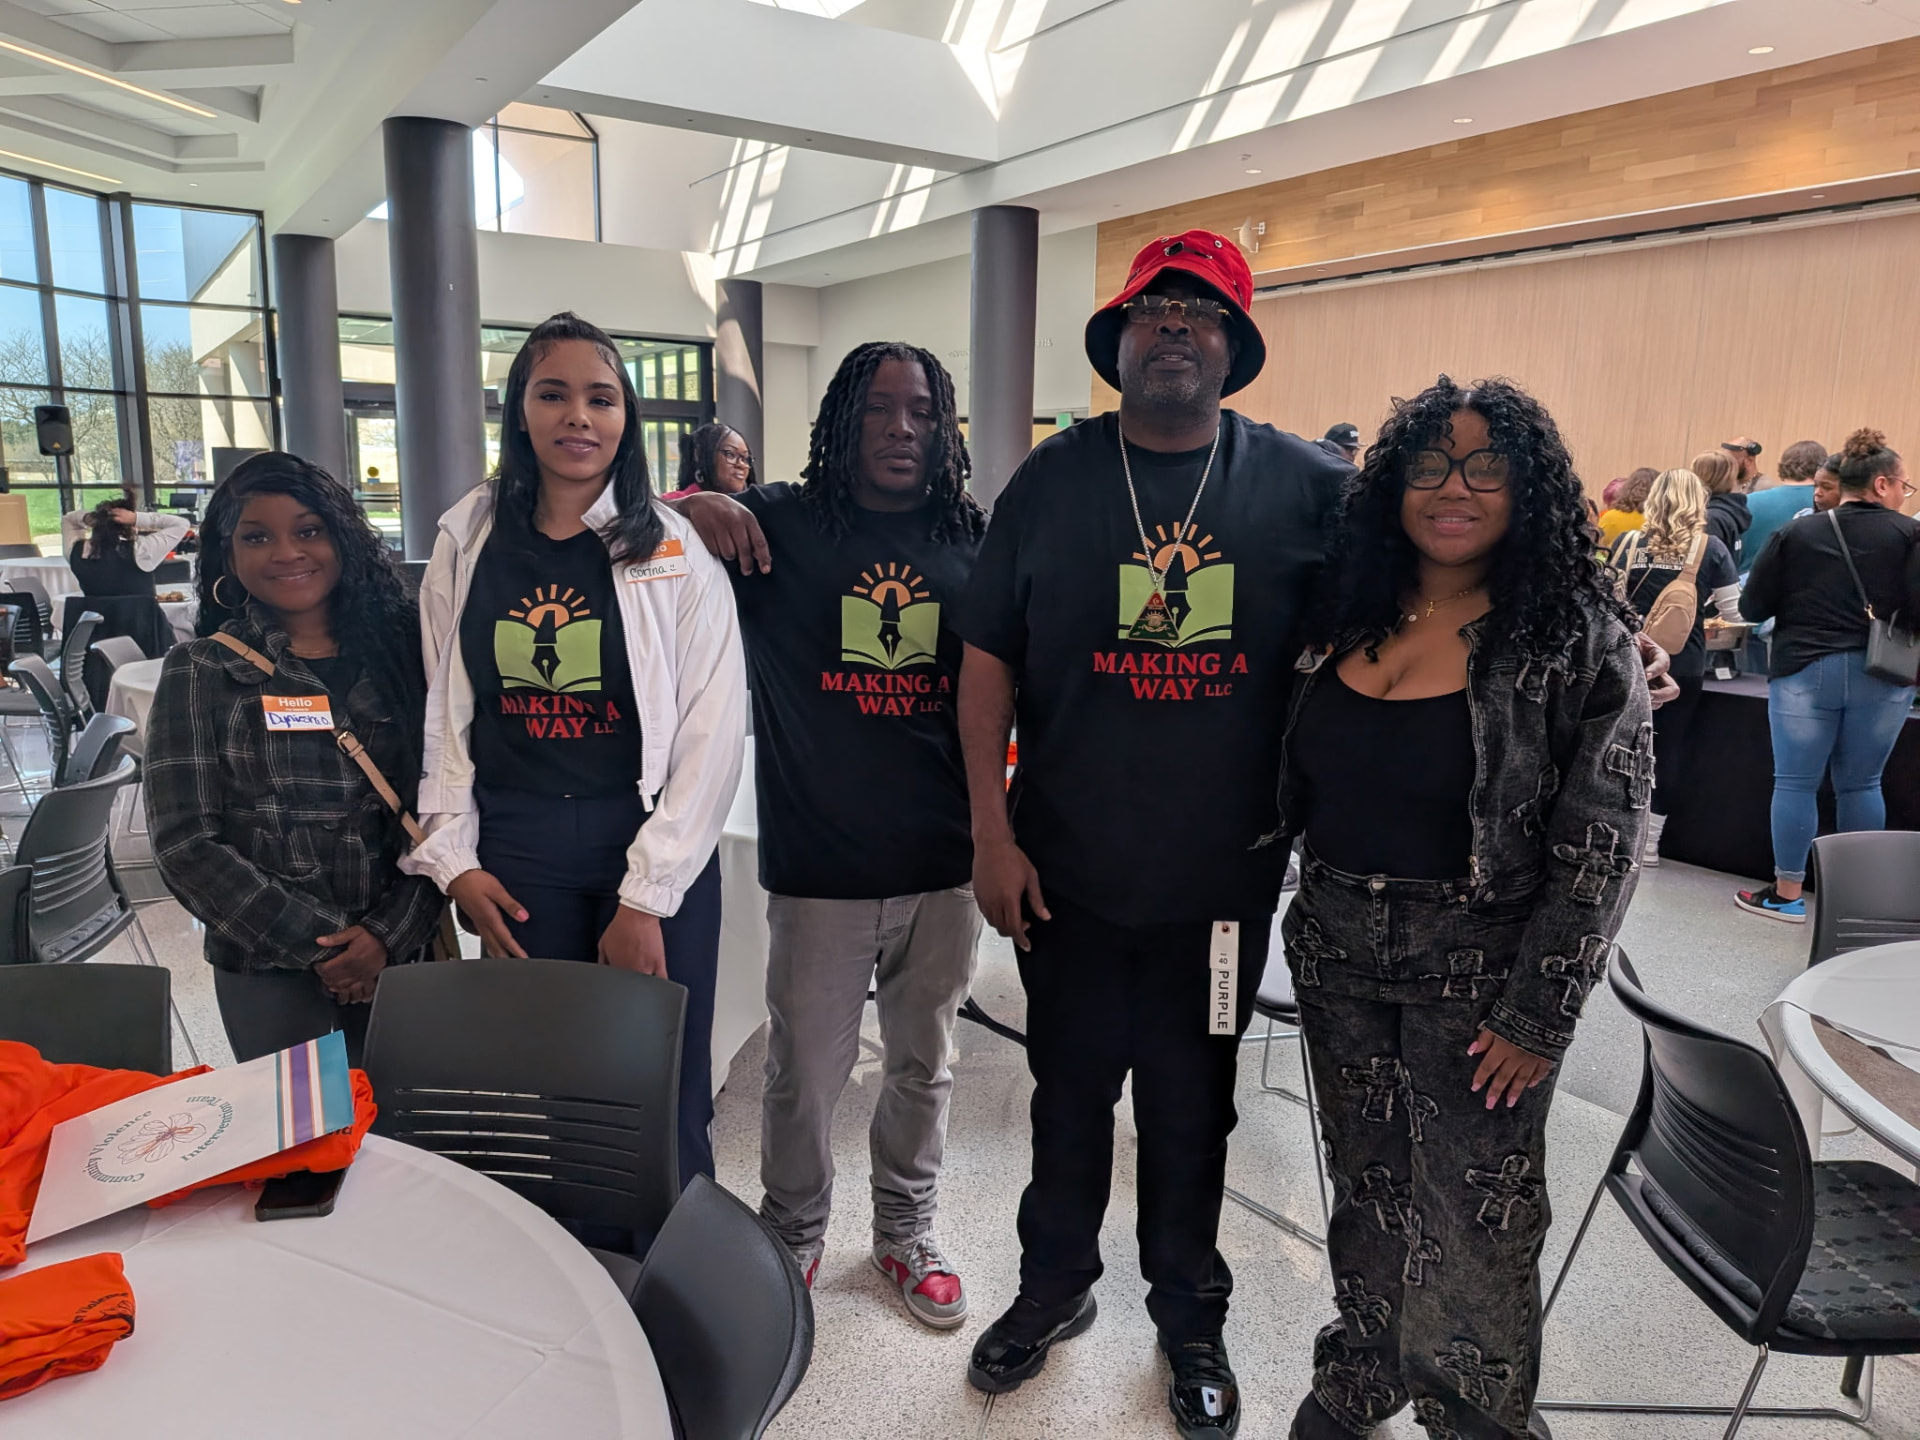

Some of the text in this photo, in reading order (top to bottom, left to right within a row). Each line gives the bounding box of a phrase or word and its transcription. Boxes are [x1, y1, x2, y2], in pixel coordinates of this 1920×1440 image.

[1093, 651, 1249, 675] MAKING A
[821, 672, 950, 693] MAKING A
[1129, 677, 1233, 700] WAY LLC
[278, 697, 313, 707] Hello
[606, 701, 621, 722] A
[856, 695, 943, 716] WAY LLC
[525, 717, 589, 739] WAY
[1217, 970, 1230, 1029] PURPLE
[180, 1095, 233, 1162] Intervention Team
[83, 1110, 152, 1183] Community Violence
